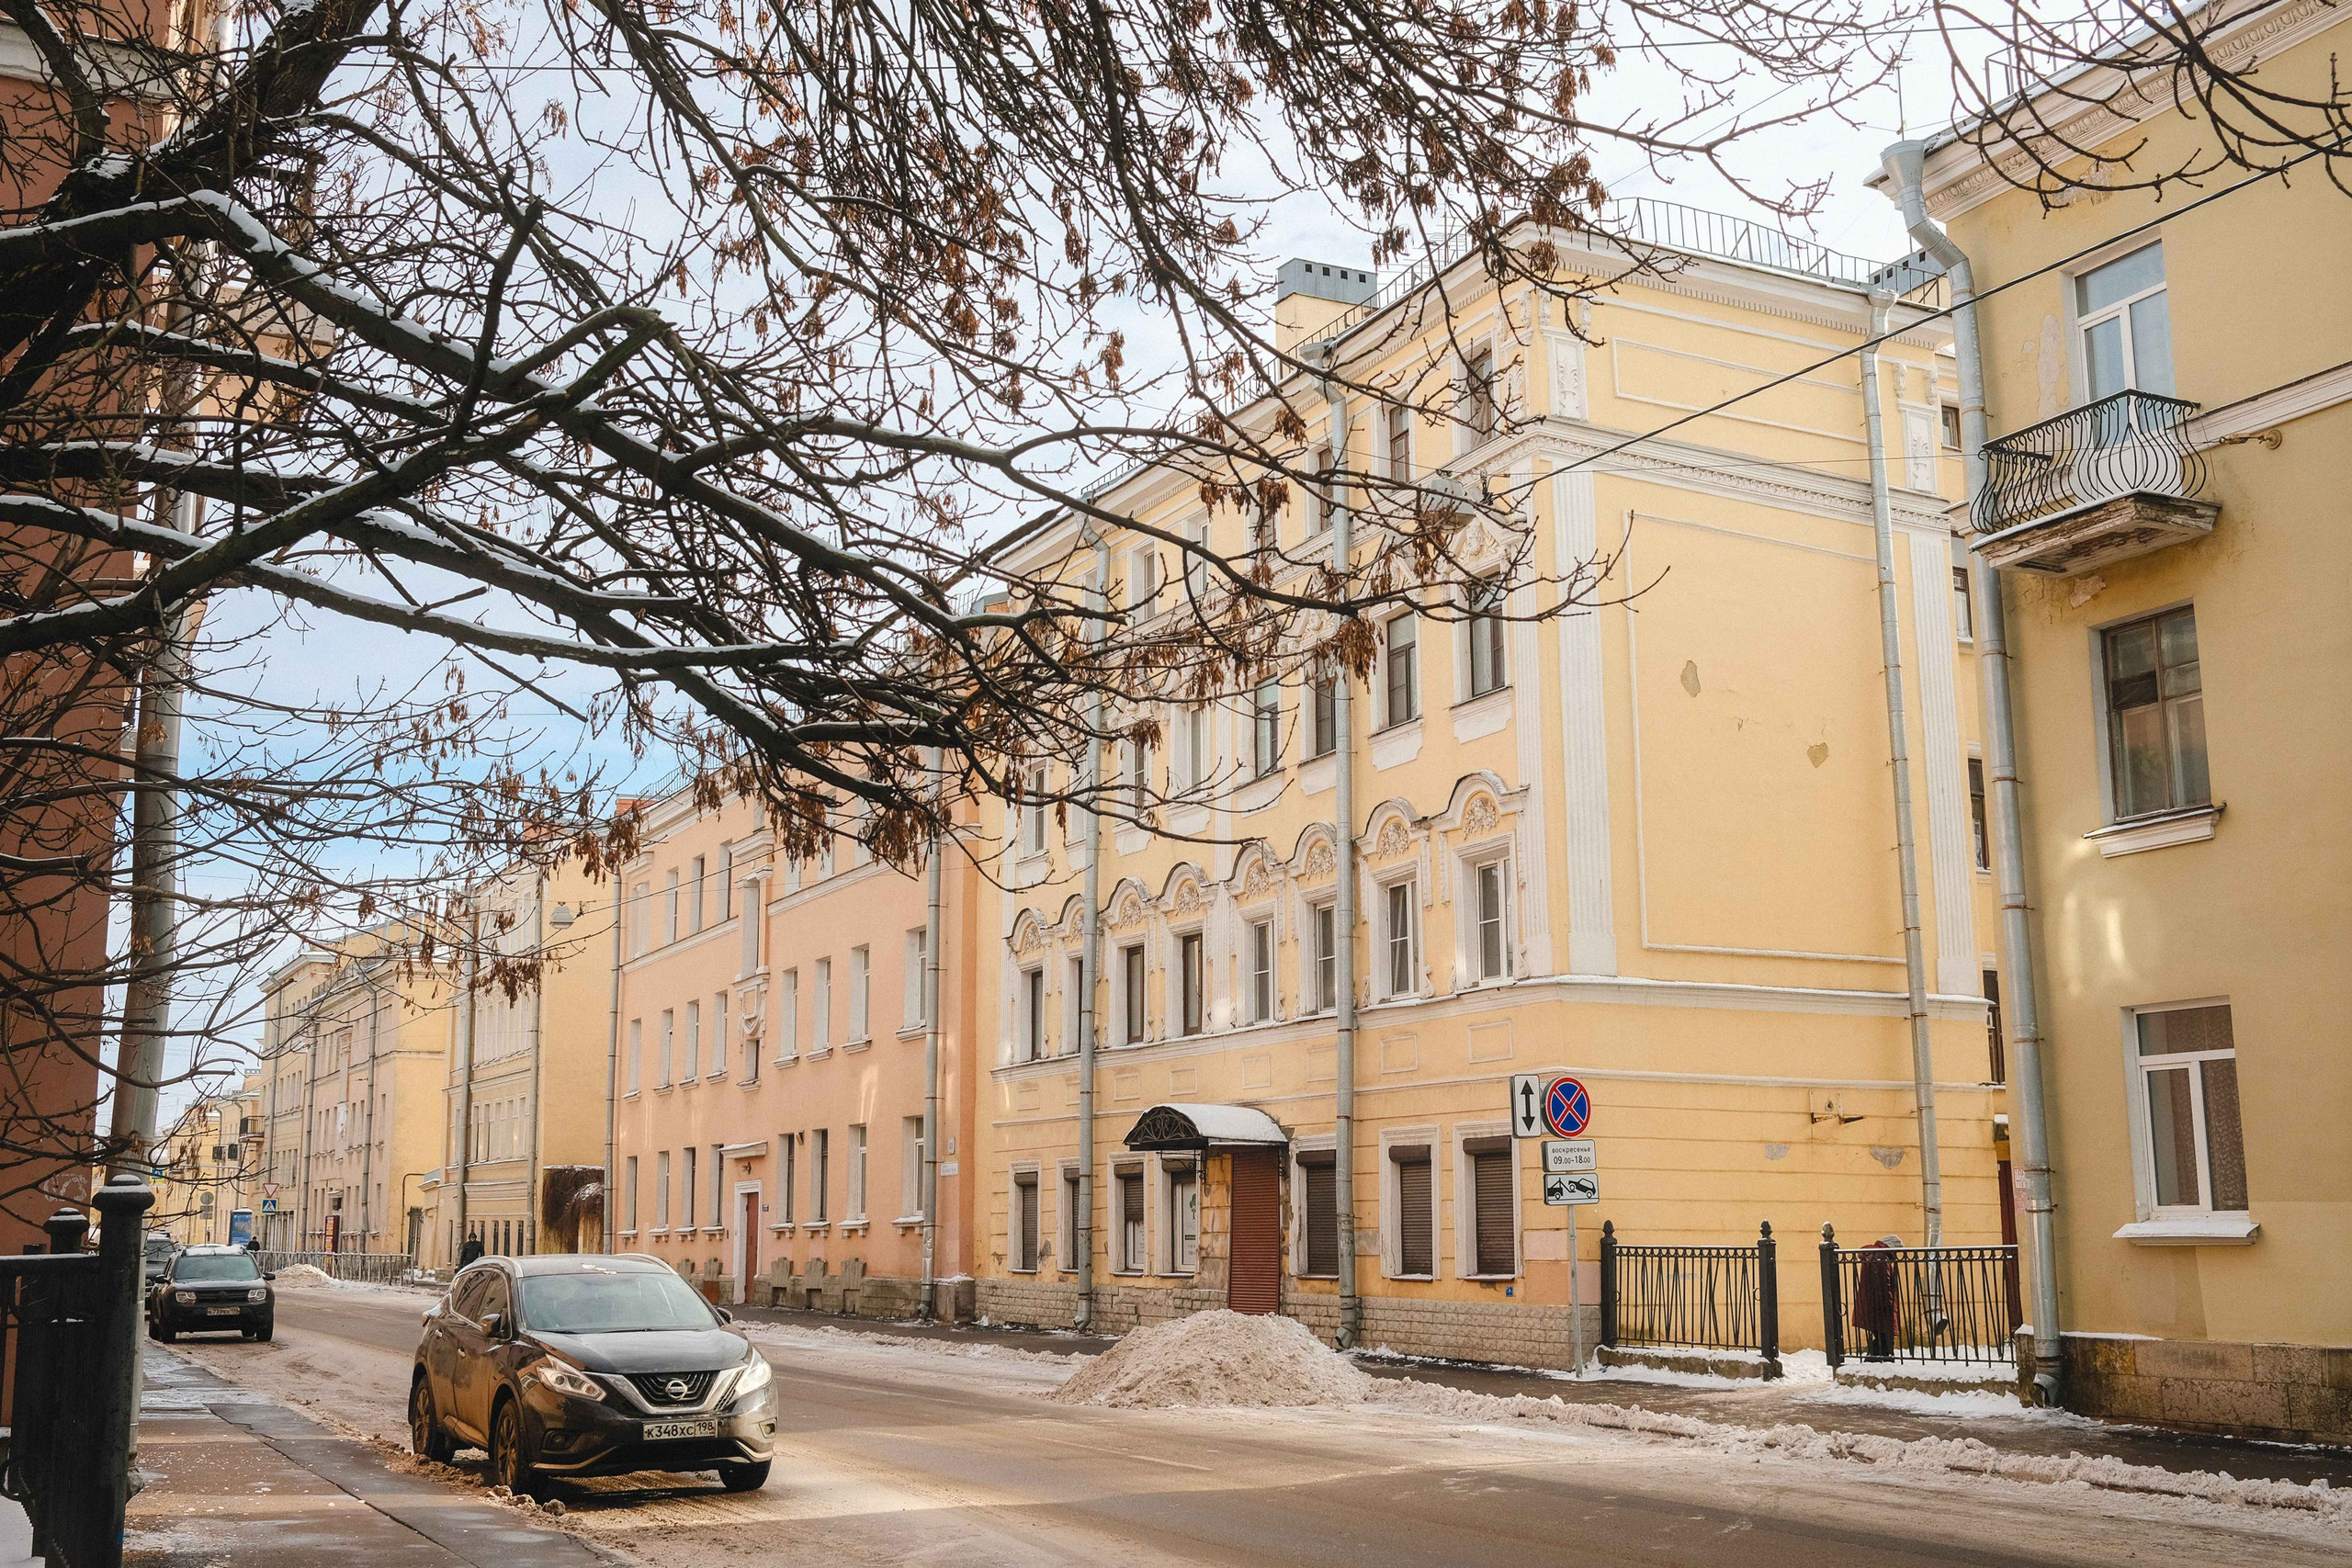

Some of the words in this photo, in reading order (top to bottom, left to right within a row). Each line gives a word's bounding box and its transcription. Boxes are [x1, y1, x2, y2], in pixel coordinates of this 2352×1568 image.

[1552, 1146, 1591, 1155] воскресенье
[1553, 1155, 1591, 1165] 09.00-18.00
[647, 1424, 694, 1438] К348ХС
[695, 1421, 714, 1432] 198
